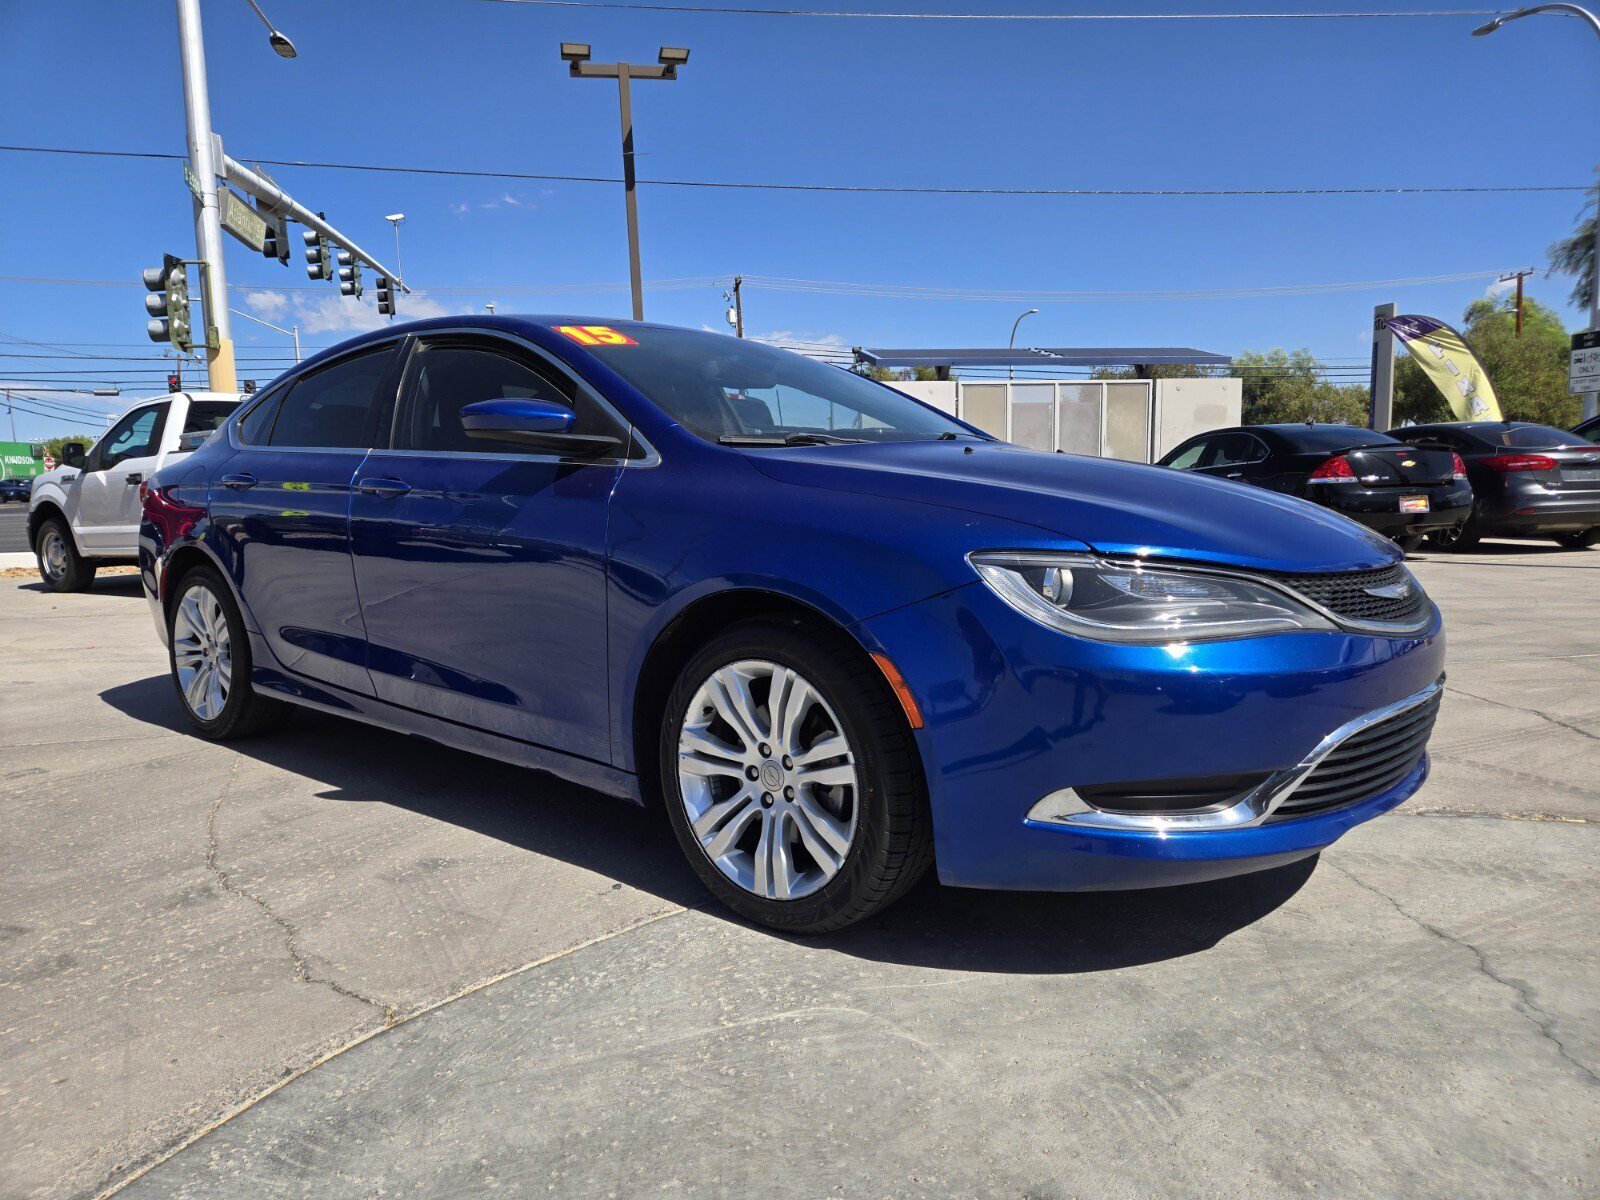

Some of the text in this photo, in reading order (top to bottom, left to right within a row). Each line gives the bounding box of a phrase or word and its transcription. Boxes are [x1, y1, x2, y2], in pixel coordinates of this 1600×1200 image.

[560, 326, 627, 344] 15
[1578, 366, 1595, 374] ONLY
[4, 455, 35, 465] KNUDSON
